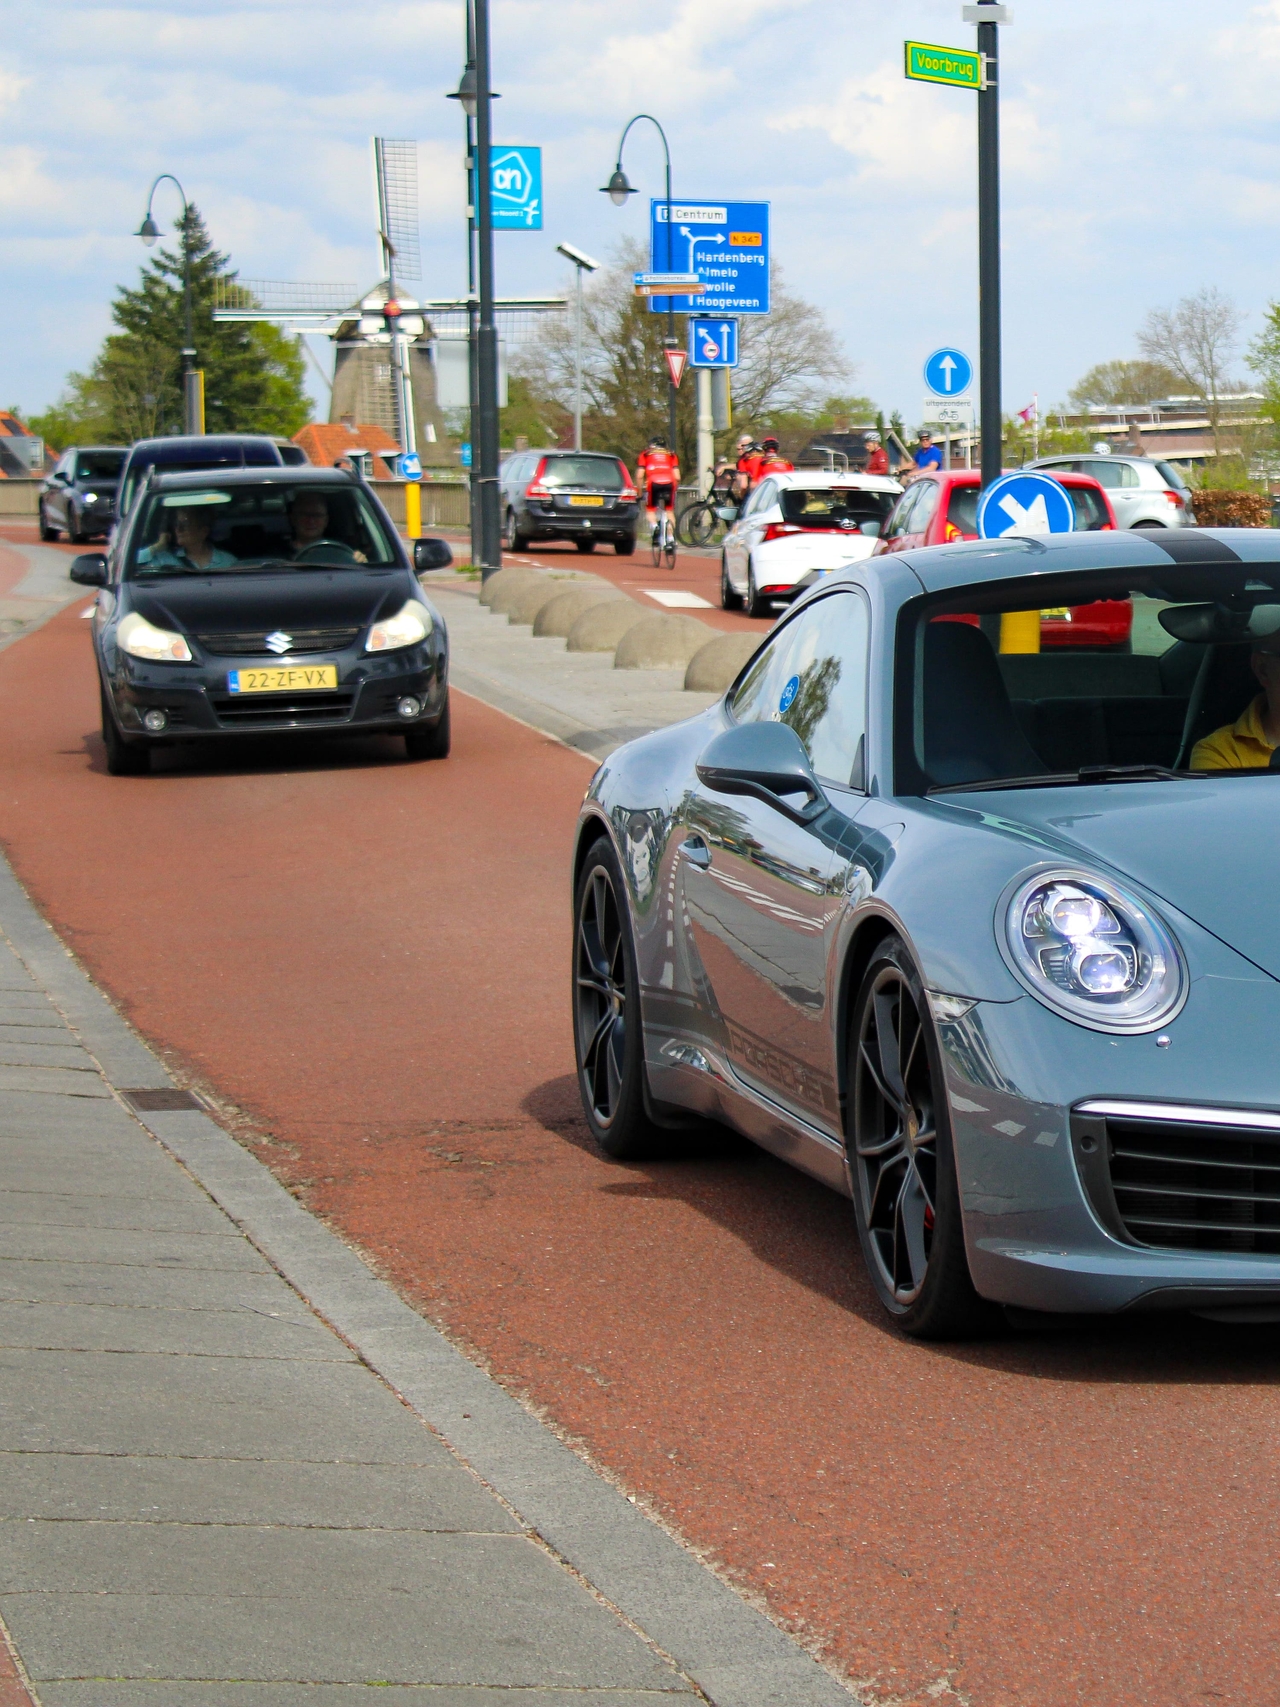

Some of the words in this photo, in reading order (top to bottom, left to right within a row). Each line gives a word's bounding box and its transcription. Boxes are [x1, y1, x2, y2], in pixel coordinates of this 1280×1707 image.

[916, 52, 973, 81] Voorbrug
[676, 209, 724, 221] Centrum
[733, 236, 739, 244] N
[741, 235, 760, 244] 347
[697, 252, 764, 267] Hardenberg
[698, 266, 738, 278] Almelo
[705, 282, 736, 293] wolle
[697, 297, 759, 309] Hoogeveen
[926, 400, 972, 408] uitgezonderd
[247, 669, 327, 689] 22-ZF-VX
[730, 1027, 826, 1110] PORSCHE
